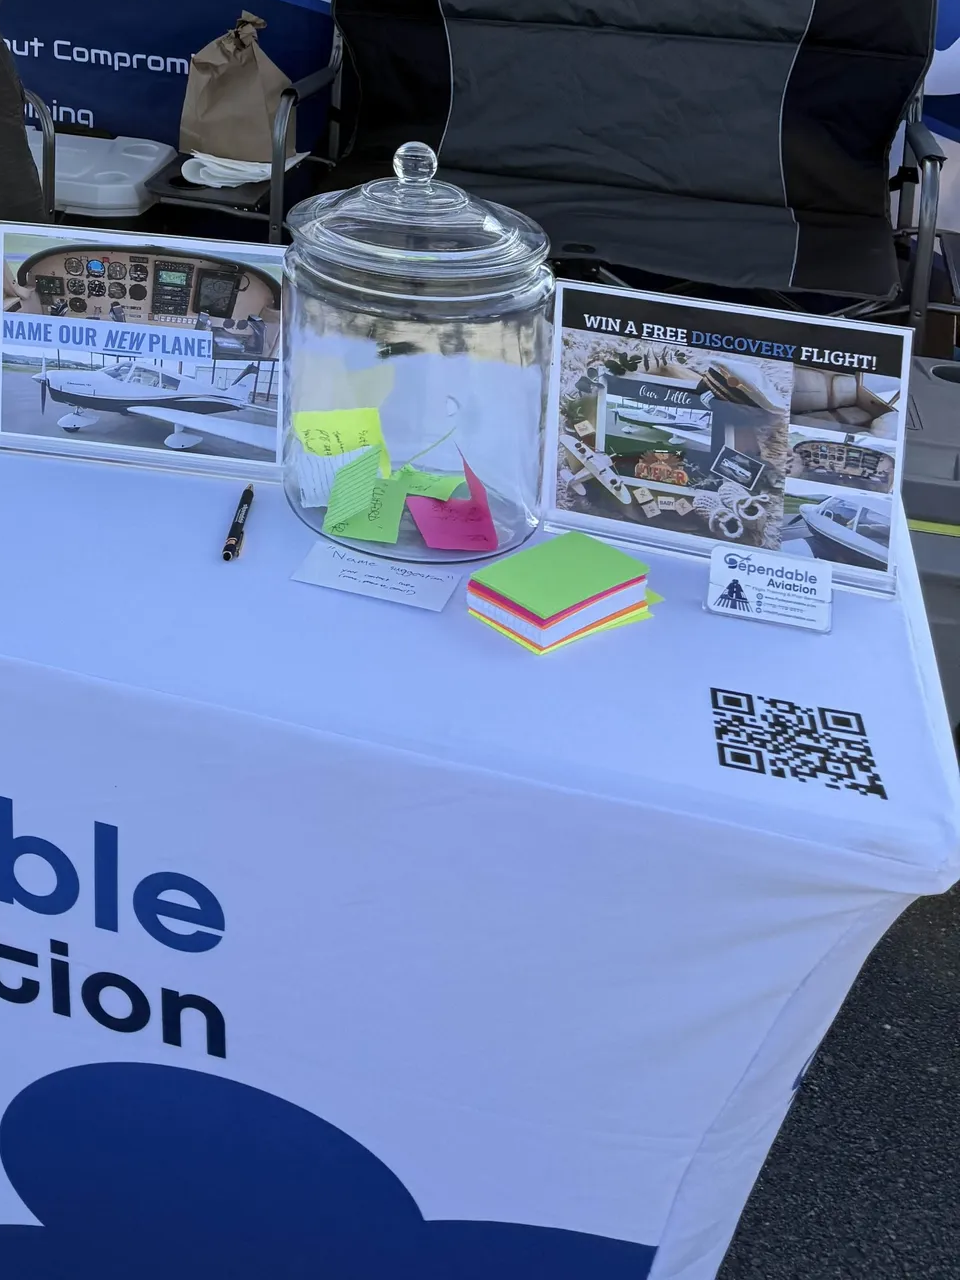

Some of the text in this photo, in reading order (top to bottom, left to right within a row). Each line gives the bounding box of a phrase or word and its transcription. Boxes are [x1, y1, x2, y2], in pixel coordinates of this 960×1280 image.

[53, 39, 196, 76] Comprom
[2, 319, 213, 360] NAME OUR NEW PLANE!
[583, 313, 878, 372] WIN A FREE DISCOVERY FLIGHT!
[639, 385, 659, 400] Our
[766, 578, 817, 596] Aviation
